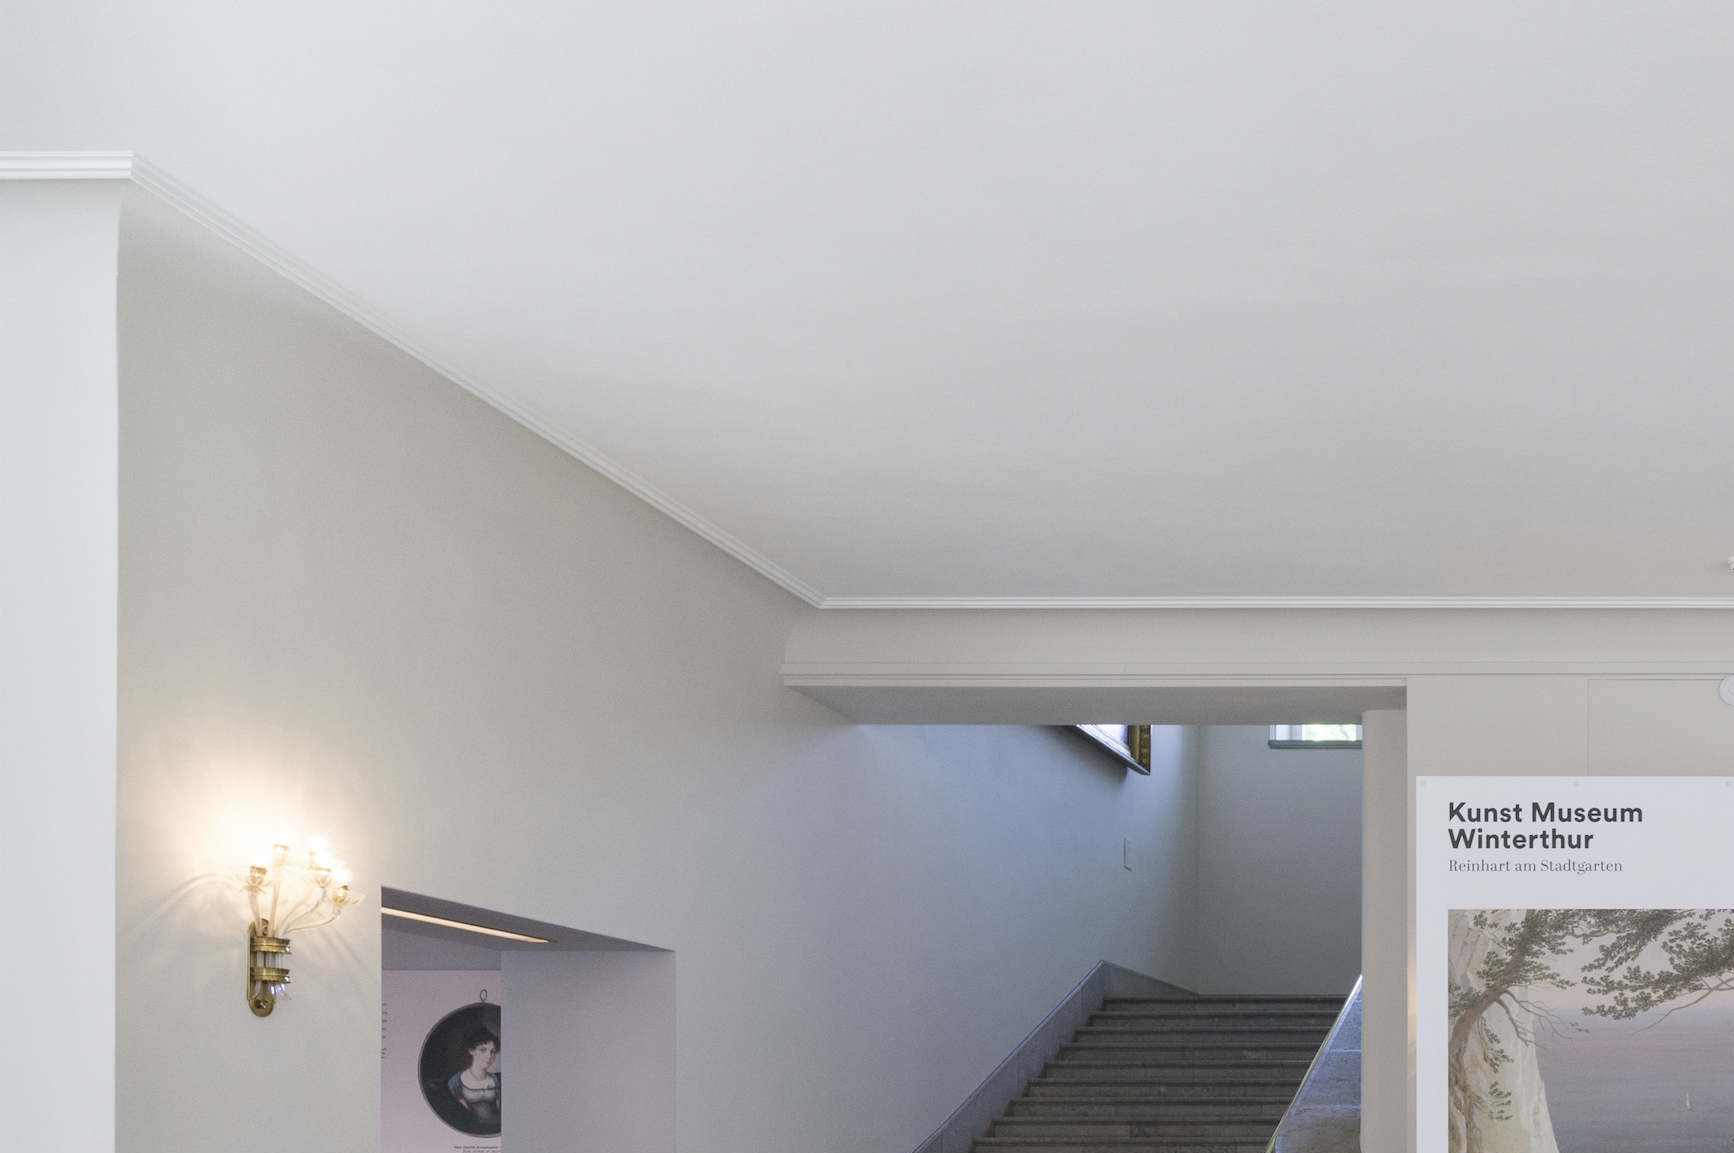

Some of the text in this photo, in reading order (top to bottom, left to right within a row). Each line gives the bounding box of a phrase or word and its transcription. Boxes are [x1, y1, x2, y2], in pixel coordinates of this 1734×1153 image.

[1448, 802, 1643, 823] Kunst Museum
[1447, 828, 1594, 850] Winterthur
[1449, 859, 1623, 876] Reinhart am Stadtgarten
